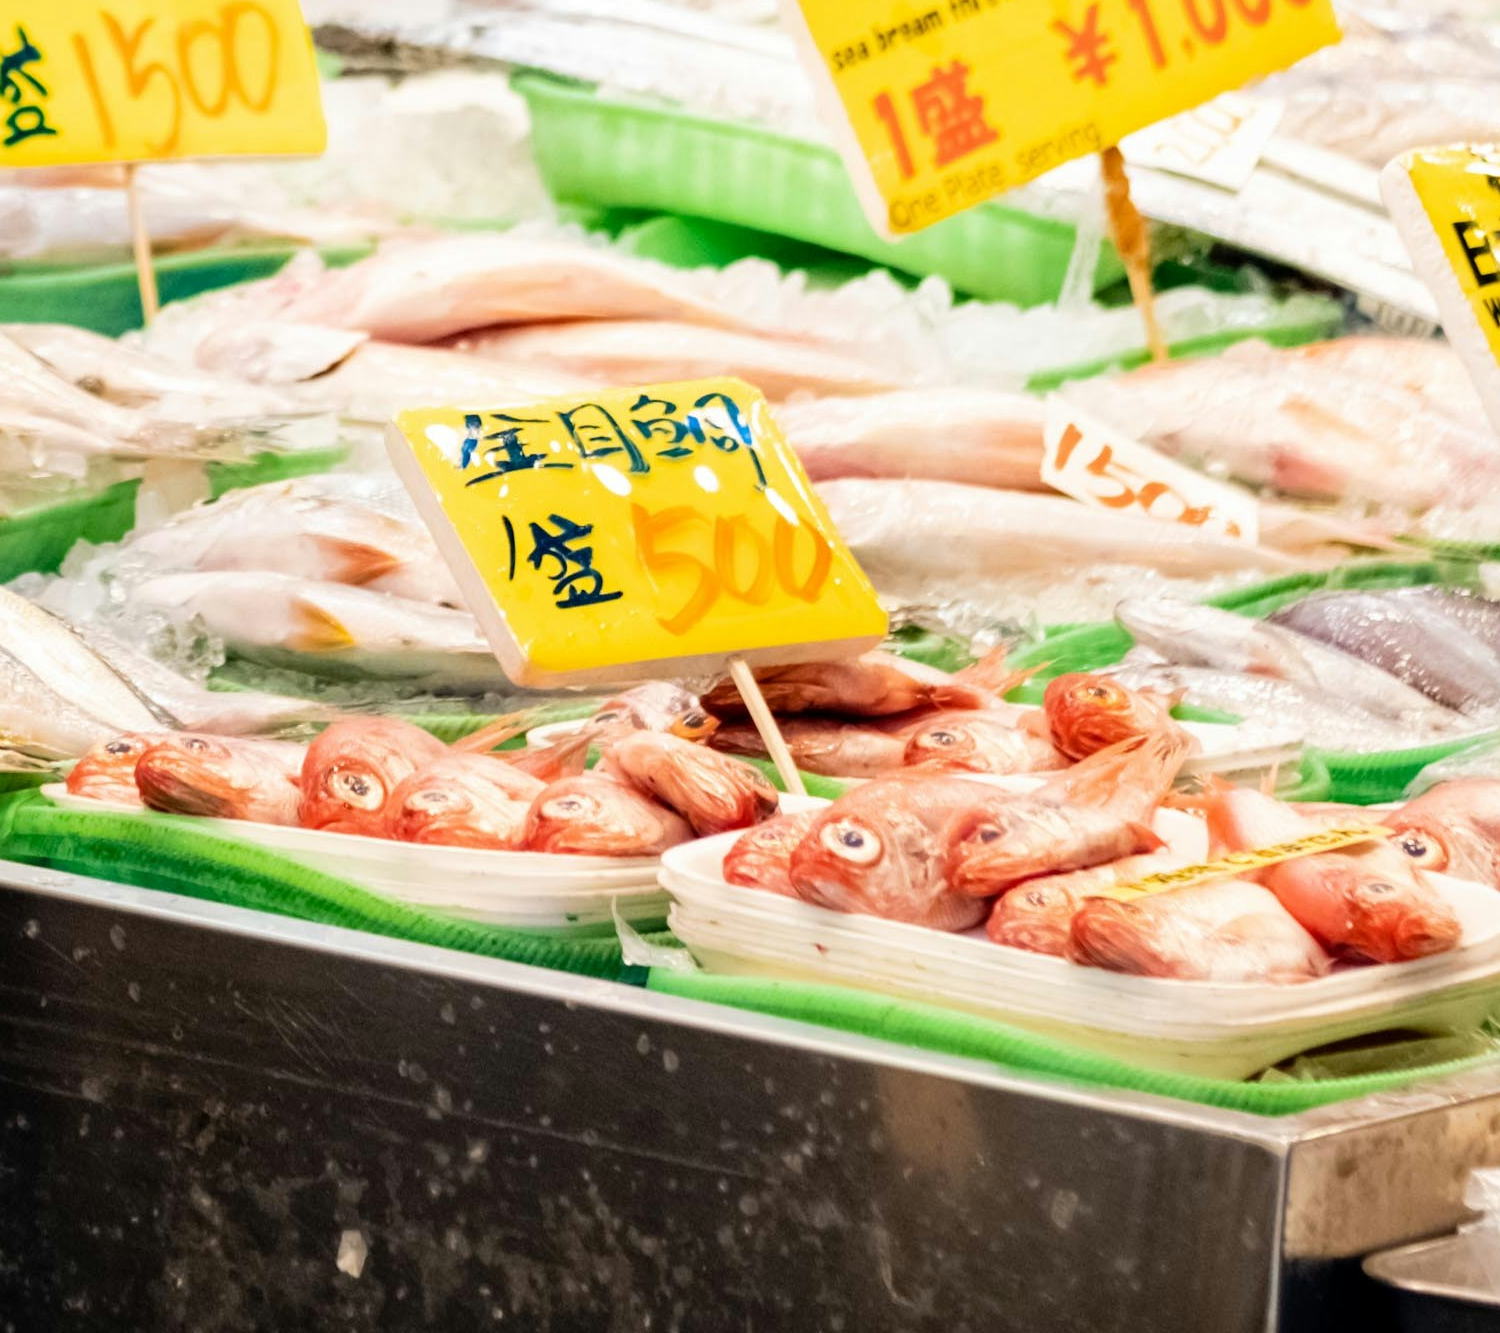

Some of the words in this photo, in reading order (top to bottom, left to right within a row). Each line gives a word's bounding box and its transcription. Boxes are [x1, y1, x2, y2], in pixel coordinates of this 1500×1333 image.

[71, 0, 281, 158] 1500
[870, 57, 1001, 181] 1盛
[887, 186, 940, 230] One
[943, 162, 1003, 206] Plate
[1014, 118, 1103, 176] serving
[630, 501, 834, 636] 500
